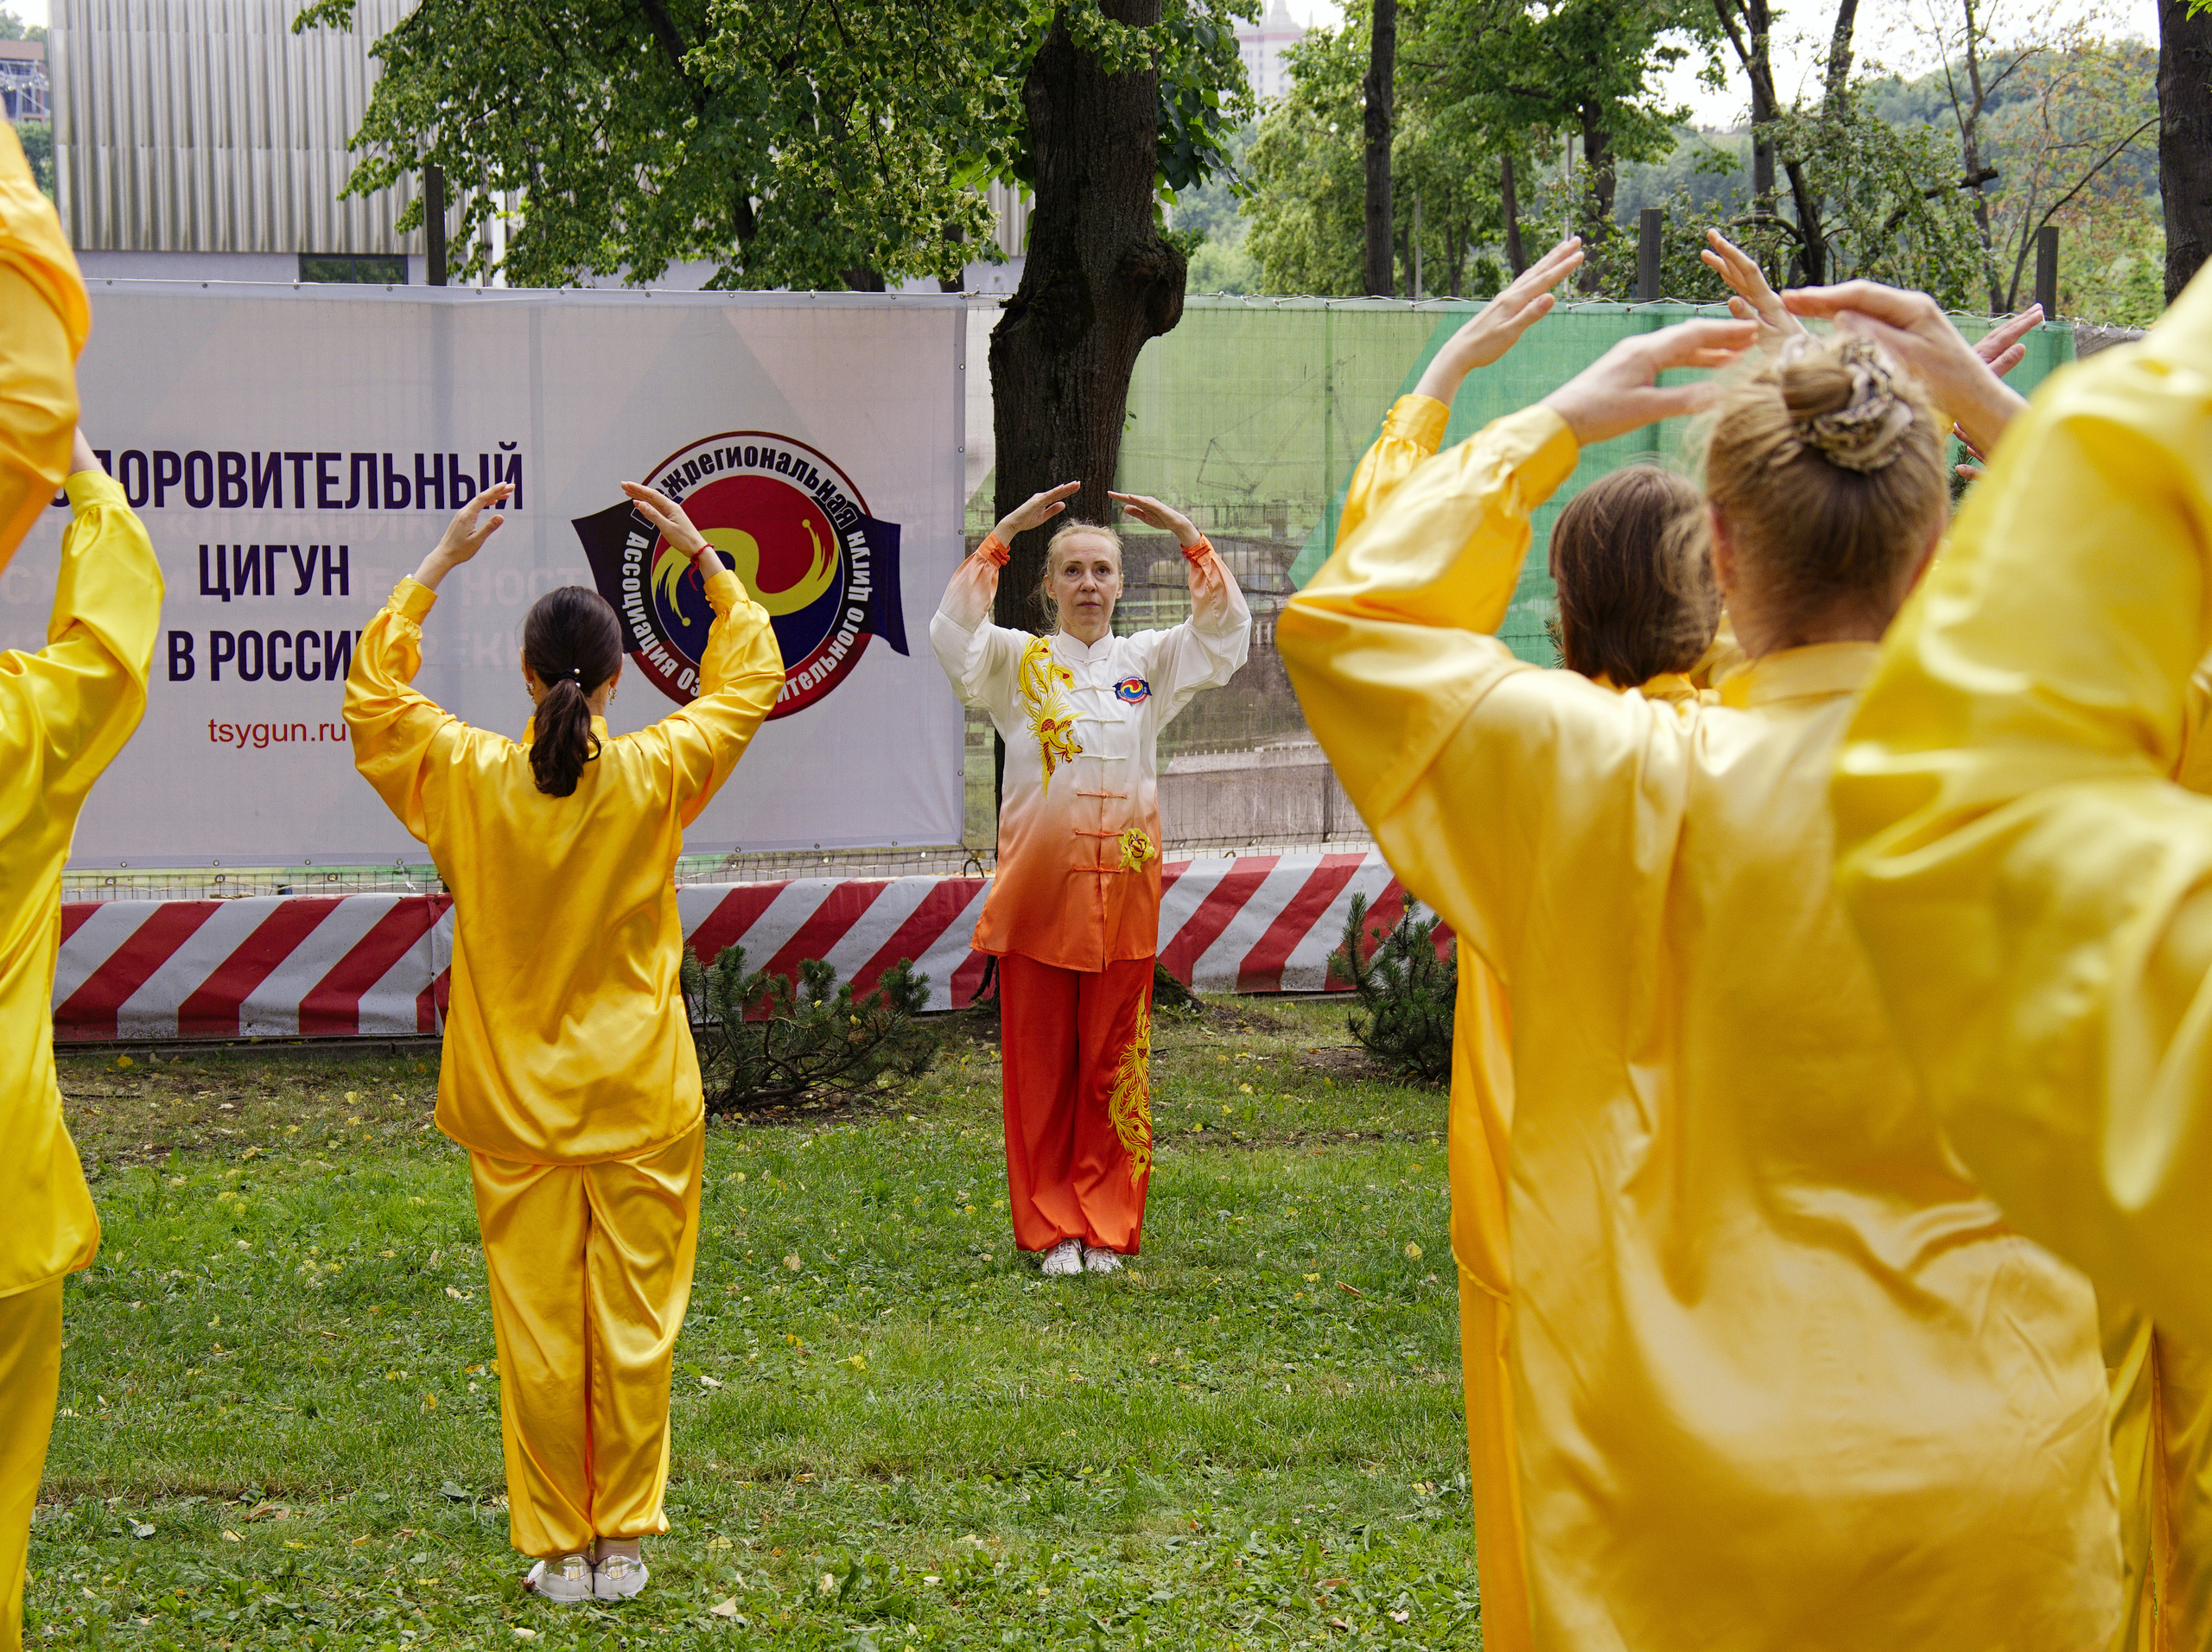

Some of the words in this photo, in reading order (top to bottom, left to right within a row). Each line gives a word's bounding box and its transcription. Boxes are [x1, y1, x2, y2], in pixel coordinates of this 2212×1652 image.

[49, 441, 523, 510] ОРОВИТЕЛЬНЫЙ
[198, 544, 350, 602] ЦИГУН
[846, 530, 874, 602] Цигун
[167, 630, 195, 682] В
[209, 629, 363, 682] РОССИ
[207, 718, 346, 749] tsygun.ru
